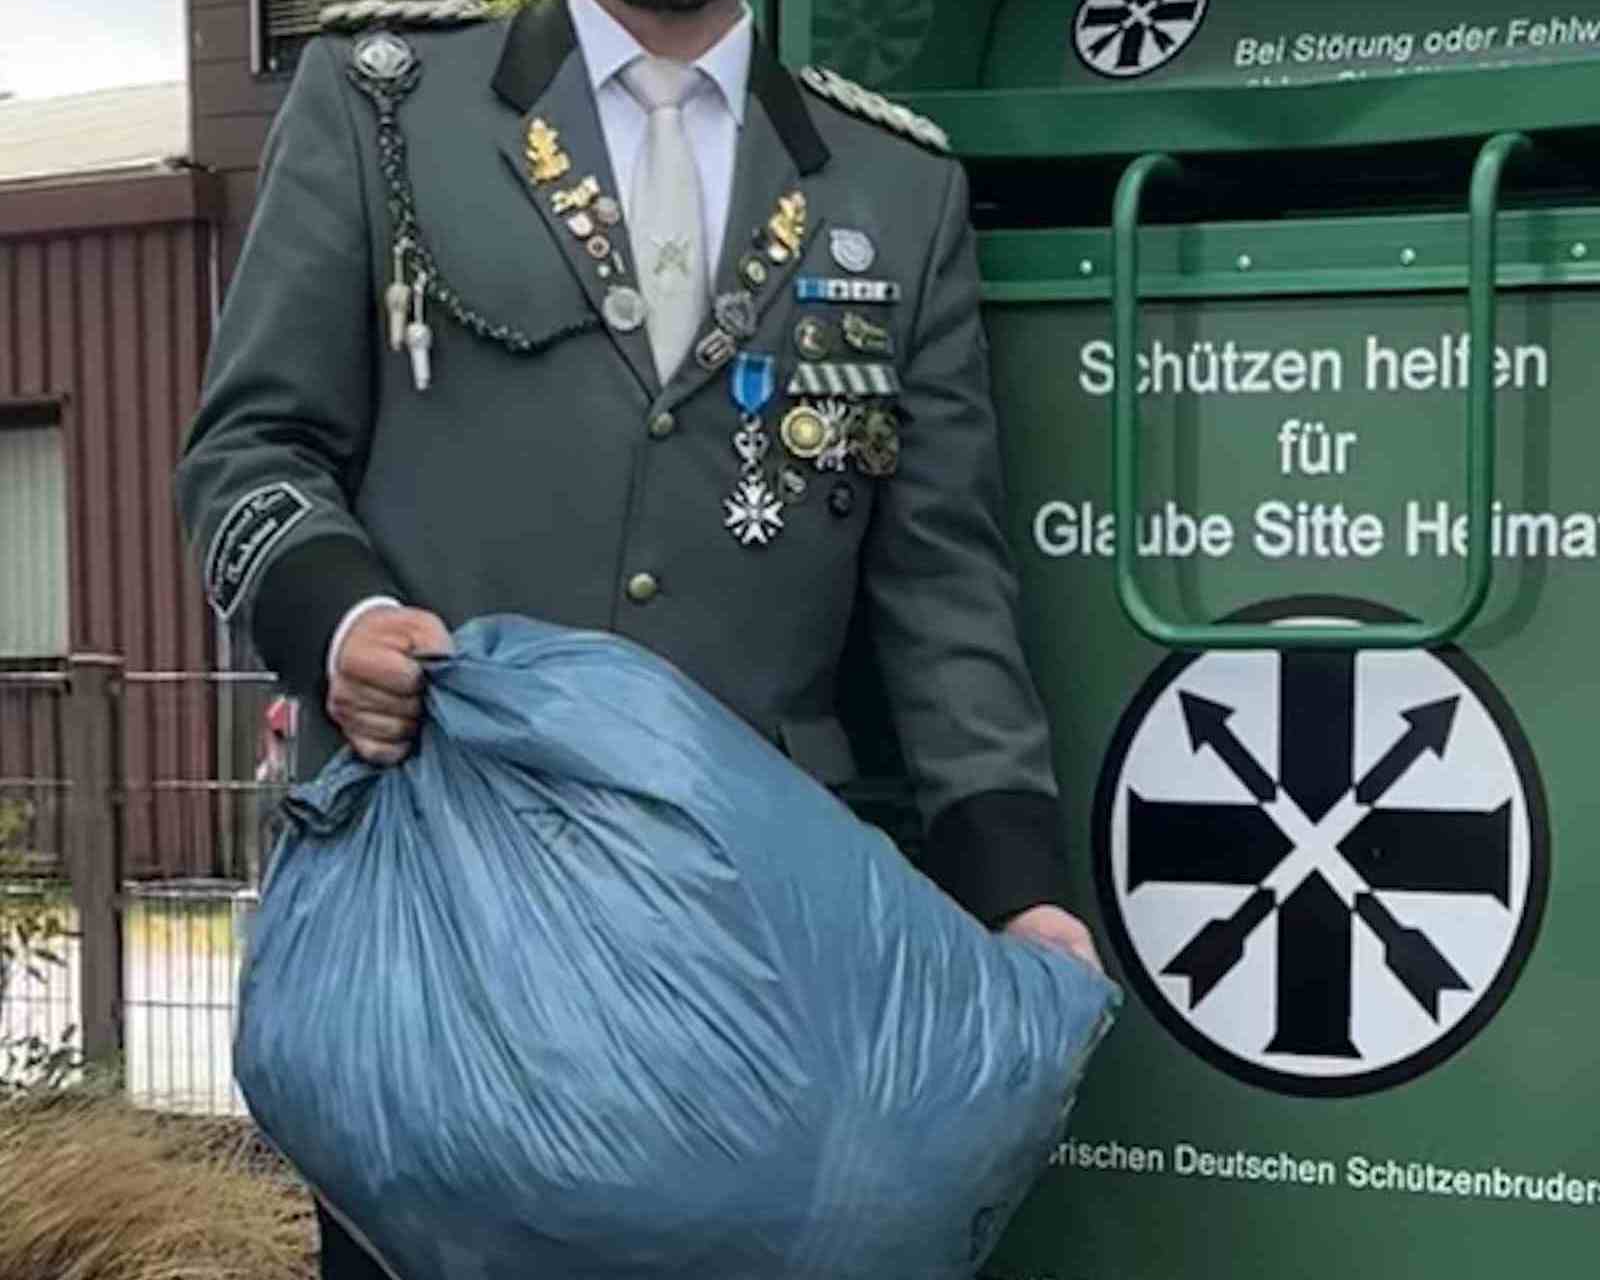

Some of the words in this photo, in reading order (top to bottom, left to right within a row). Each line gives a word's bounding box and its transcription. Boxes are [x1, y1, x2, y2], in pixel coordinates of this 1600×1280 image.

[1233, 35, 1284, 68] Bei
[1293, 30, 1413, 63] Störung
[1423, 22, 1498, 54] oder
[1277, 418, 1357, 476] für
[1253, 500, 1384, 558] Sitte
[1174, 1143, 1336, 1186] Deutschen
